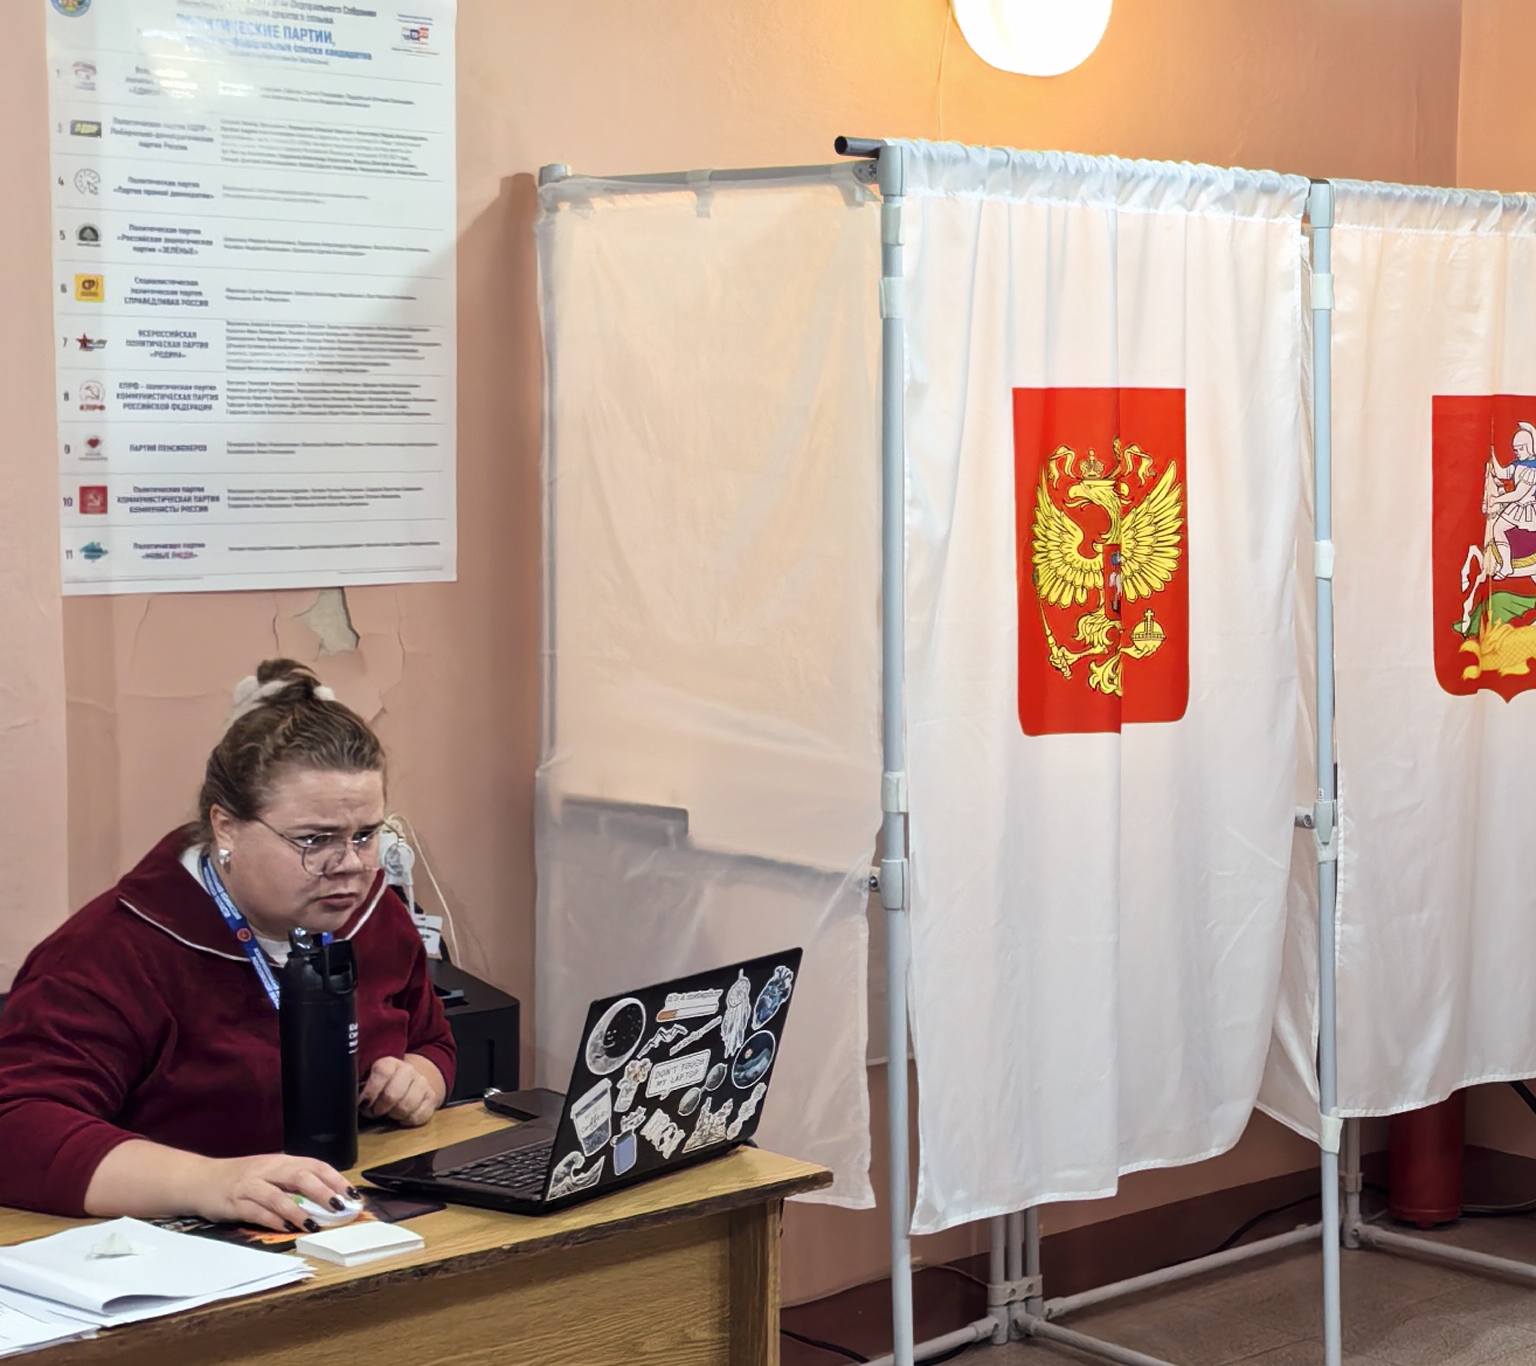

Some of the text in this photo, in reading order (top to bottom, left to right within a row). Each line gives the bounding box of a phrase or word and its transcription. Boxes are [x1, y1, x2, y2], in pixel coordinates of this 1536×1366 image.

[283, 25, 336, 46] ПАРТИИ,
[58, 176, 64, 186] 4
[59, 229, 66, 241] 5
[62, 337, 68, 348] 7
[62, 496, 73, 507] 10
